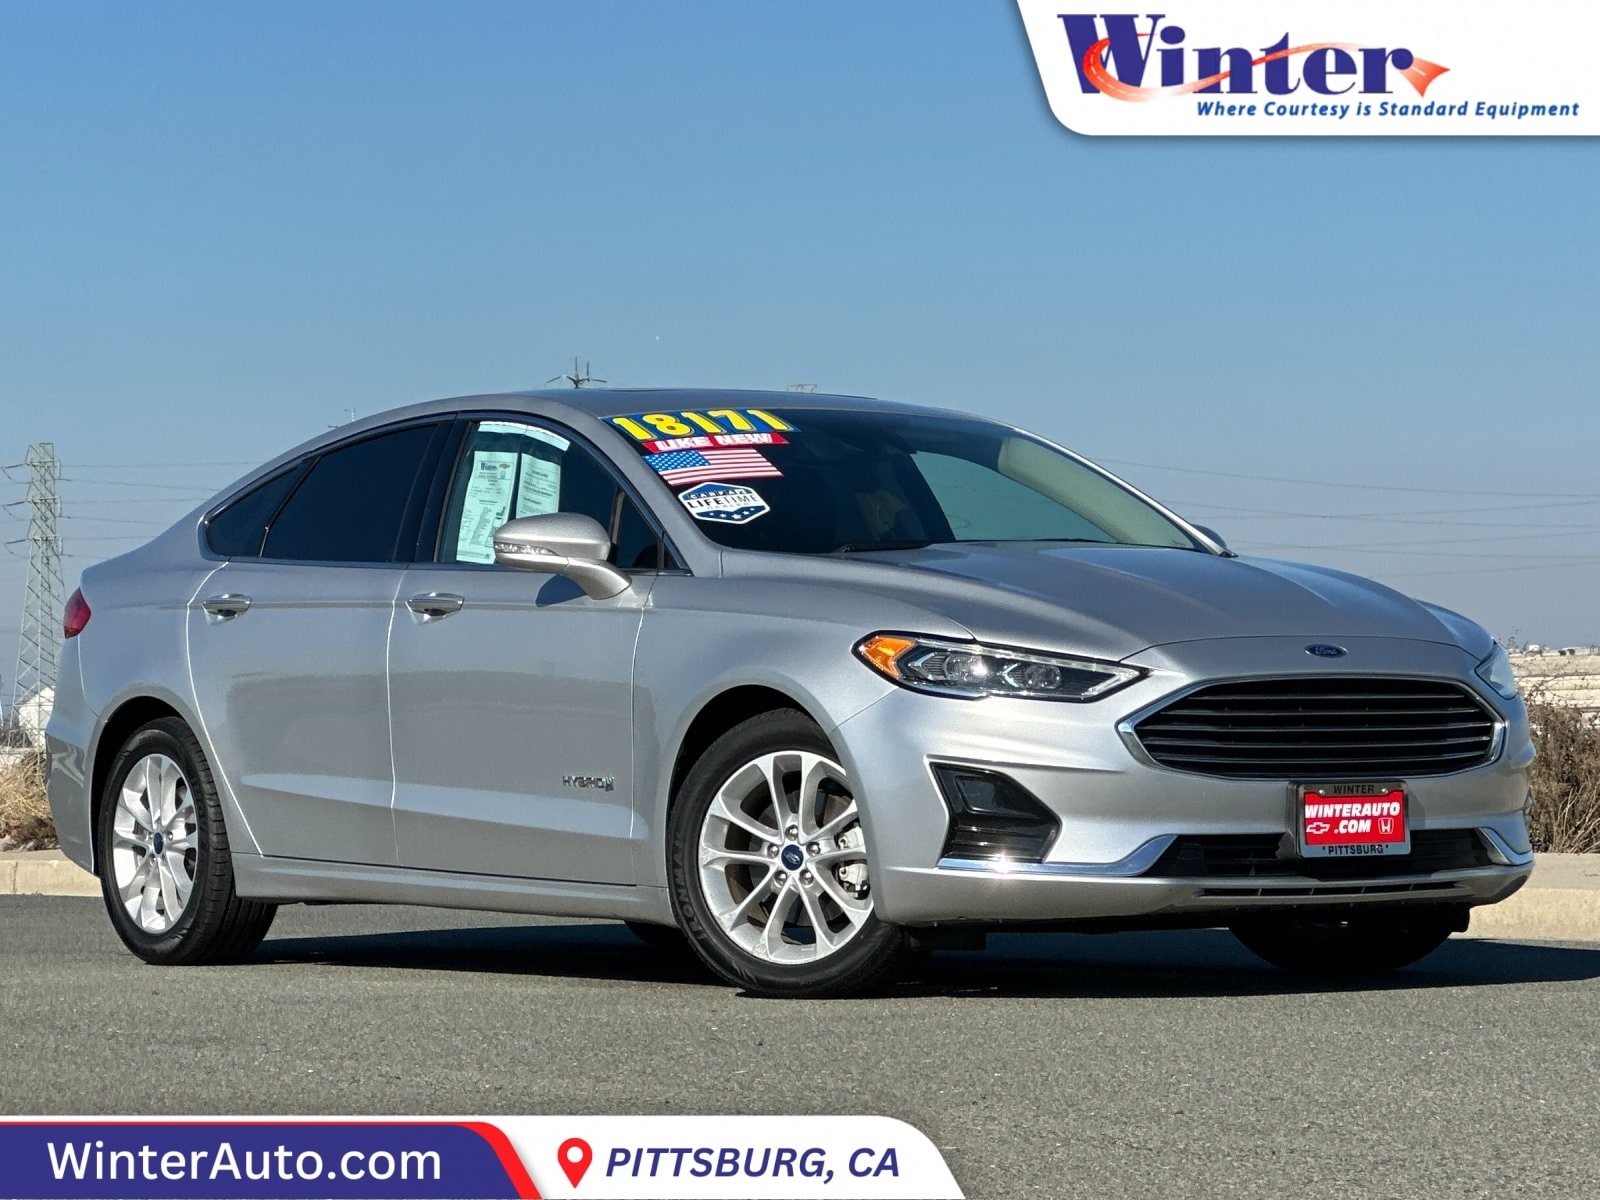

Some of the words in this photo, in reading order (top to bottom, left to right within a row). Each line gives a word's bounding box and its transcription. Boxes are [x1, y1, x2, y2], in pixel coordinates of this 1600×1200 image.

[612, 408, 791, 441] 18171
[654, 436, 713, 452] LIKE
[713, 432, 773, 446] NEW
[687, 494, 760, 509] LIFETIME
[690, 489, 746, 500] CARFAX
[562, 775, 605, 789] HYBRID
[1333, 784, 1375, 795] WINTER
[1304, 802, 1401, 818] WINTERAUTO
[1333, 819, 1372, 834] .COM
[1328, 844, 1384, 855] PITTSBURG
